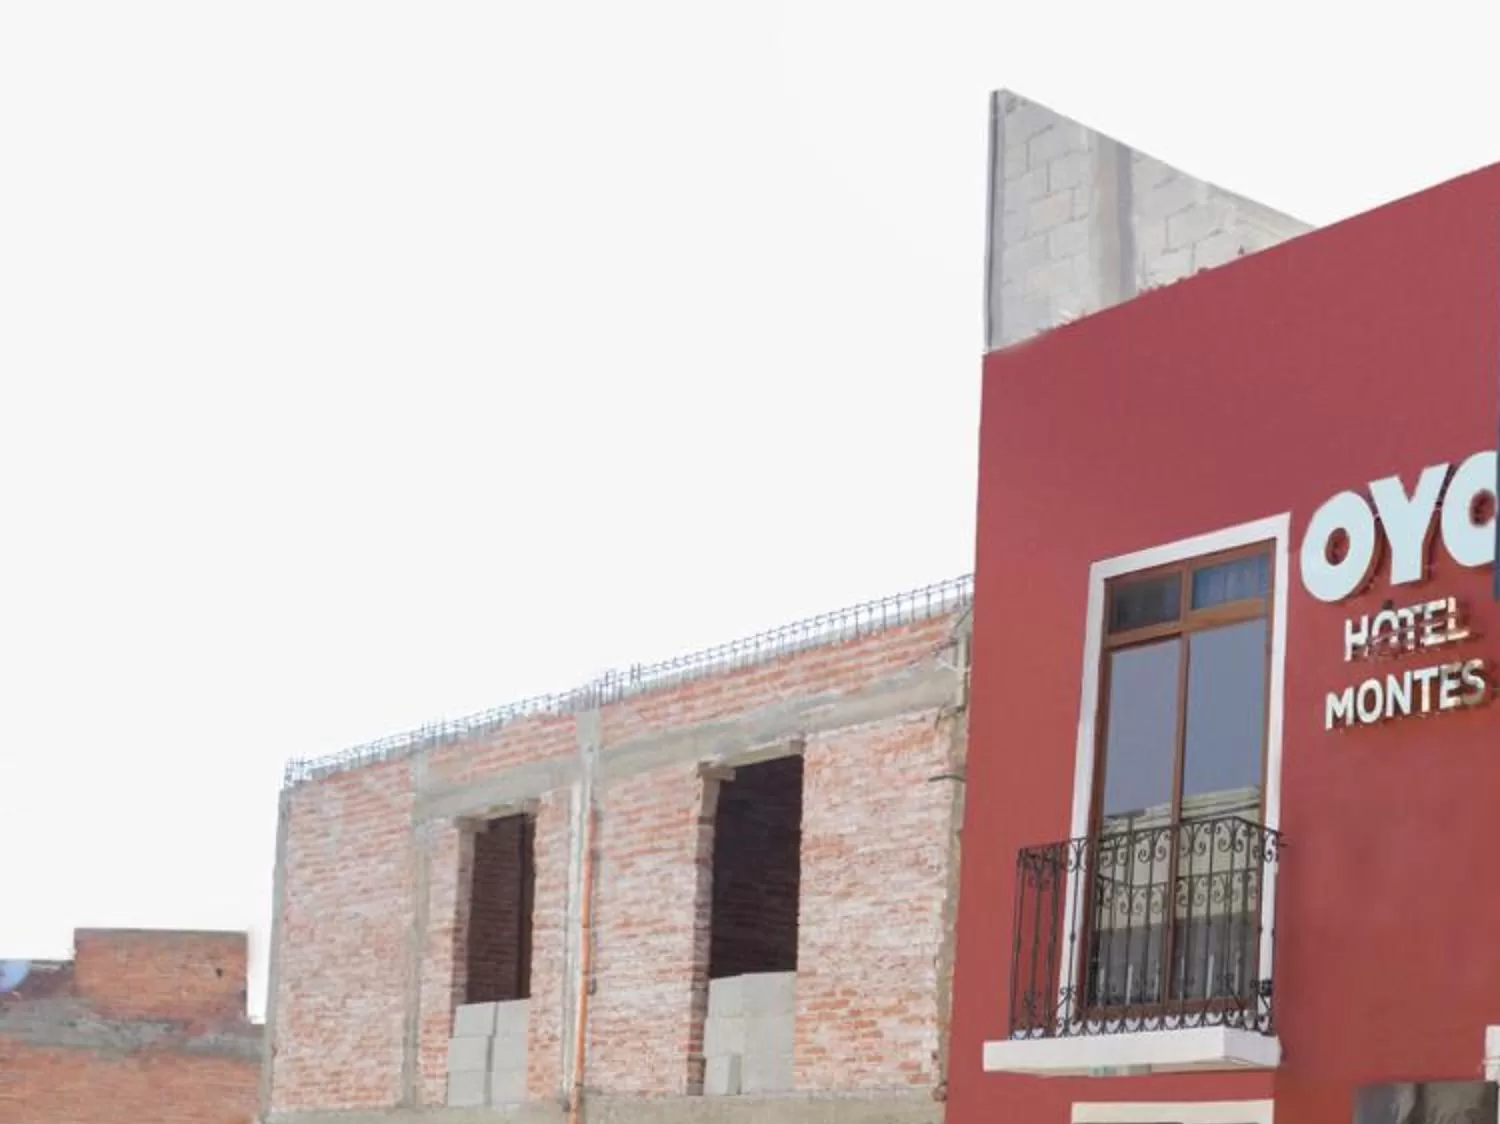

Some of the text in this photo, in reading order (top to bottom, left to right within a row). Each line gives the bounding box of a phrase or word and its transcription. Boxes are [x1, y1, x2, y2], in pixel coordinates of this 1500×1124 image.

[1301, 450, 1498, 602] OYO
[1344, 596, 1470, 662] HOTEL
[1325, 658, 1486, 731] MONTES
